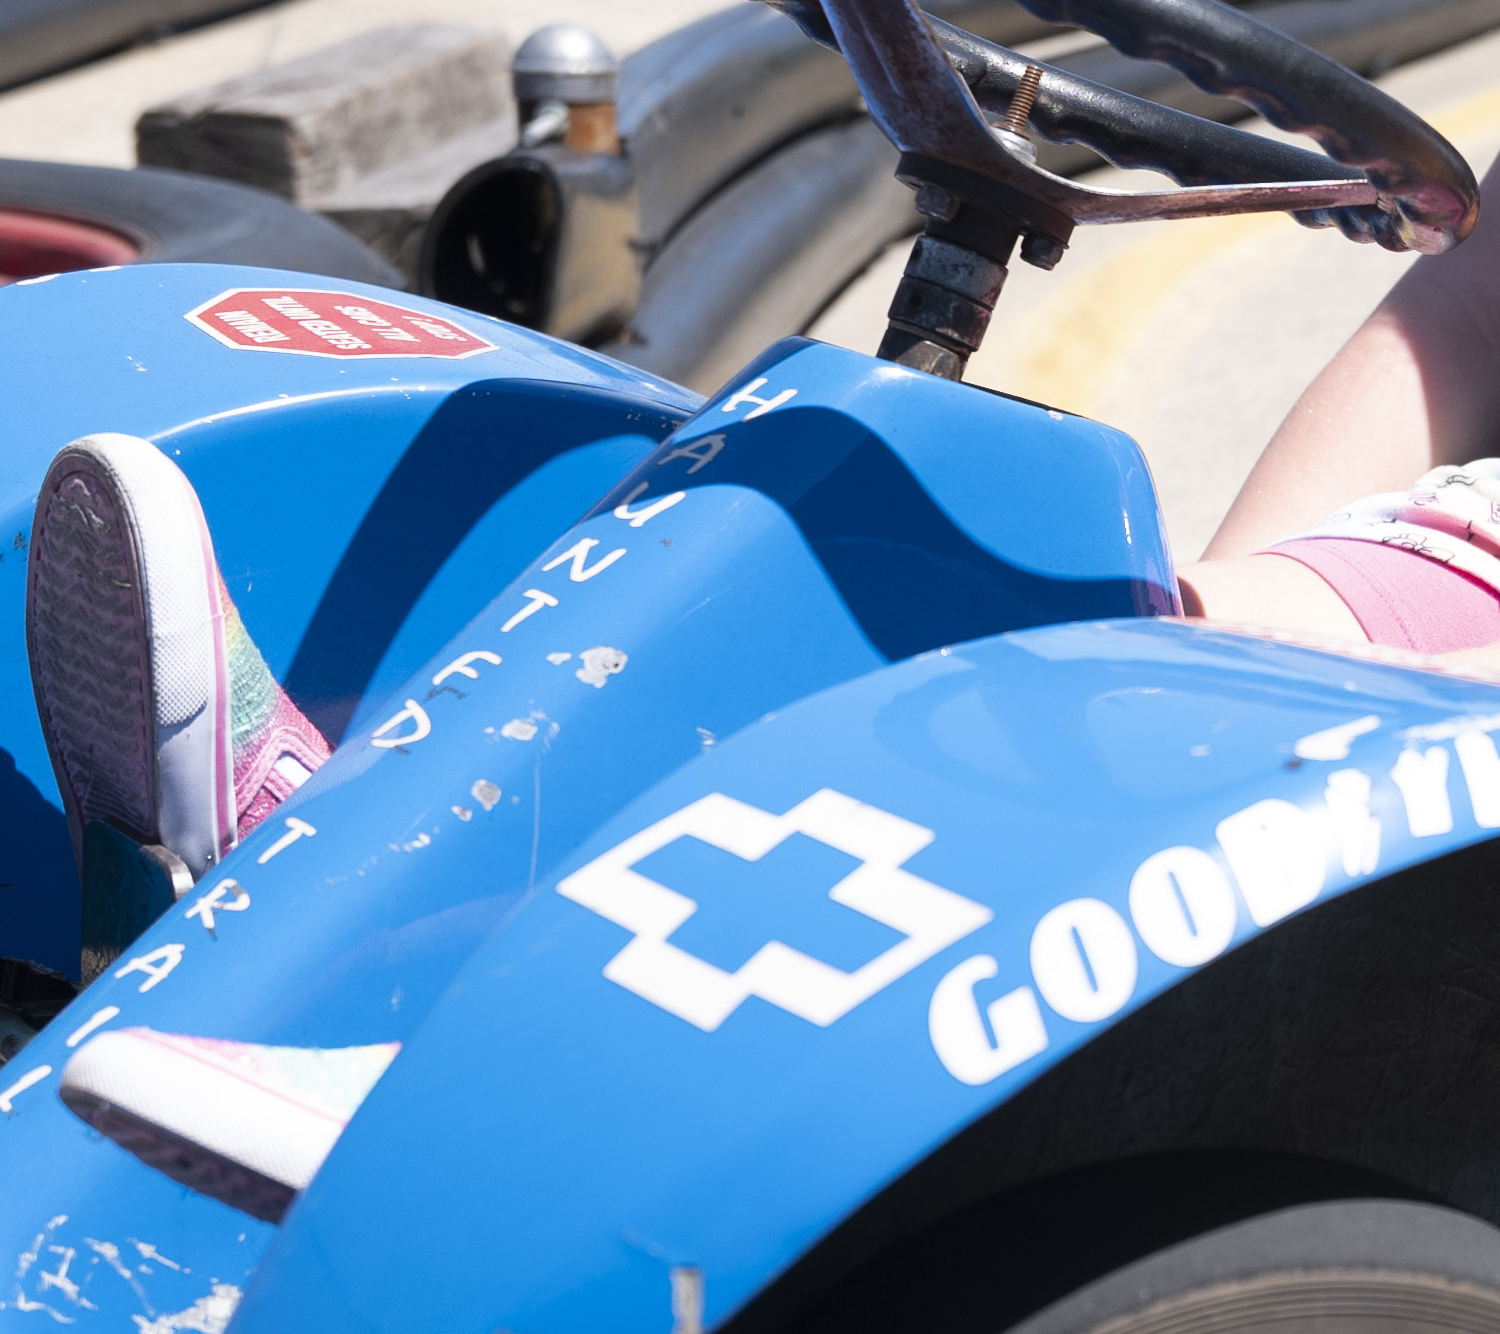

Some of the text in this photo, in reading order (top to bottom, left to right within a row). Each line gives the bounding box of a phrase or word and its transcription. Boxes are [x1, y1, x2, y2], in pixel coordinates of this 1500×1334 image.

[214, 310, 291, 344] REMAIN
[260, 295, 372, 351] SEATED UNTIL
[332, 304, 421, 343] ALL CARS
